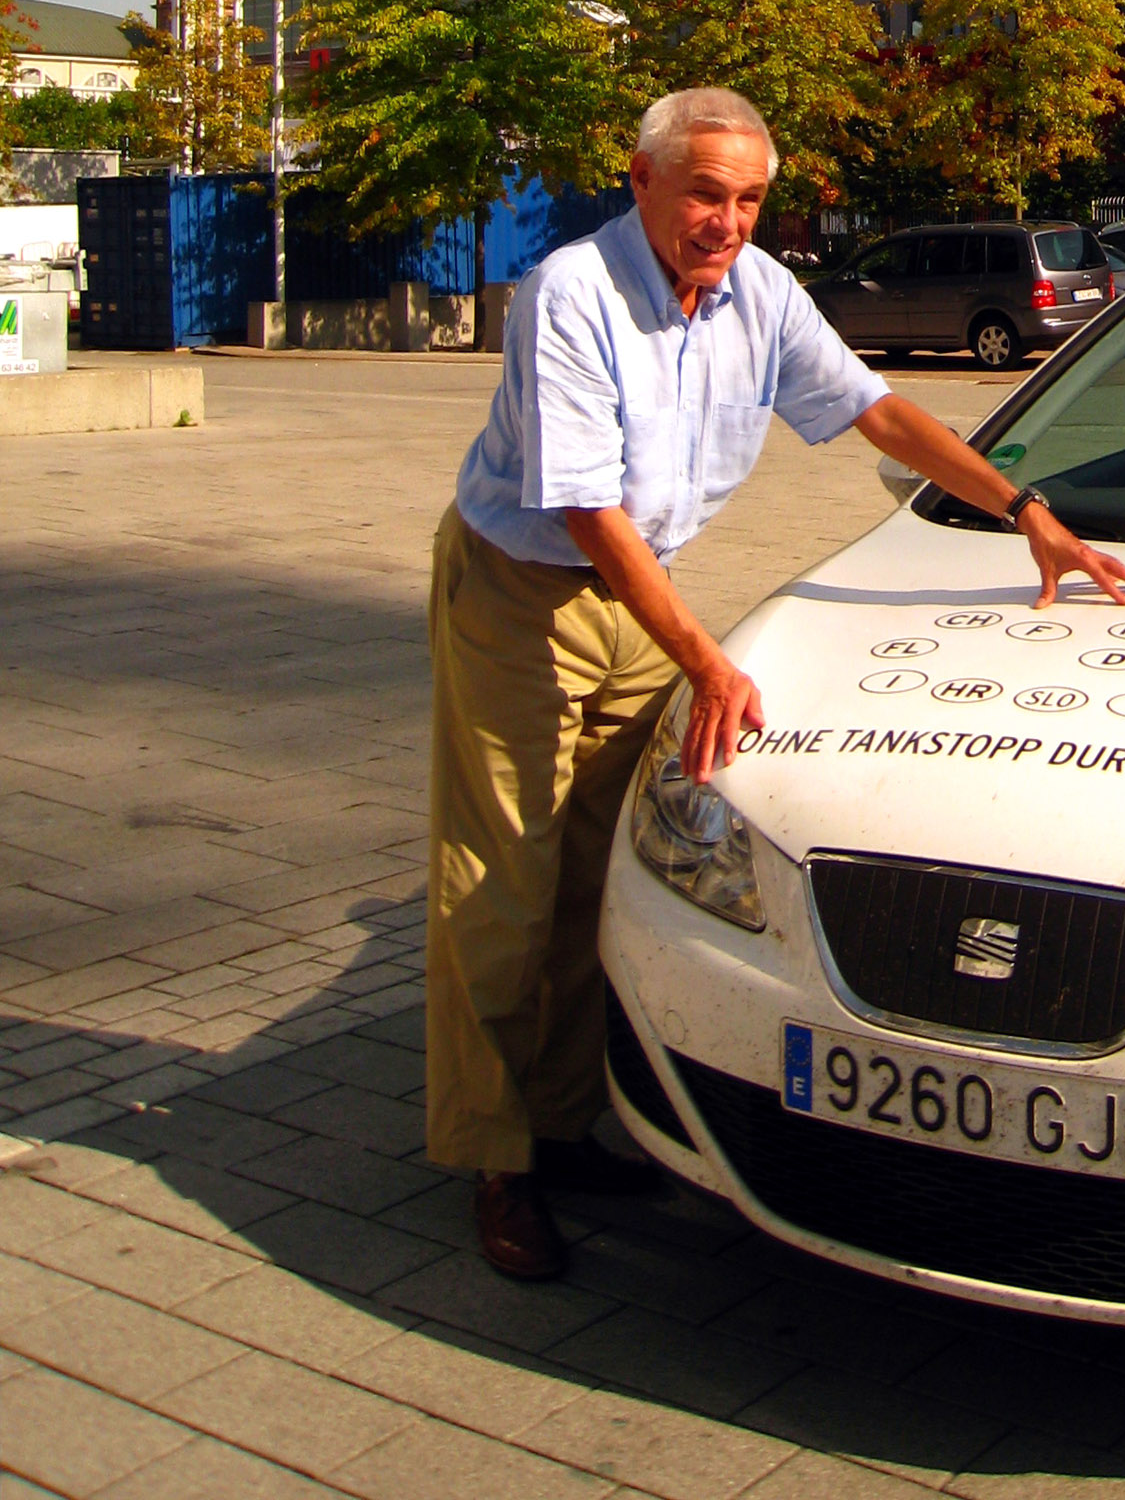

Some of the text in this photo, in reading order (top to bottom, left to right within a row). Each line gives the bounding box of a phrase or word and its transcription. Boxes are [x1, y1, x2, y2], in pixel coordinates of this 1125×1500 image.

[946, 614, 994, 626] CH
[1025, 625, 1053, 636] F
[882, 642, 919, 654] FL
[886, 675, 901, 688] I
[940, 683, 993, 698] HR
[1025, 691, 1077, 707] SLO
[737, 728, 834, 754] OHNE
[838, 729, 1043, 761] TANKSTOPP
[793, 1076, 805, 1095] E
[825, 1045, 994, 1141] 9260
